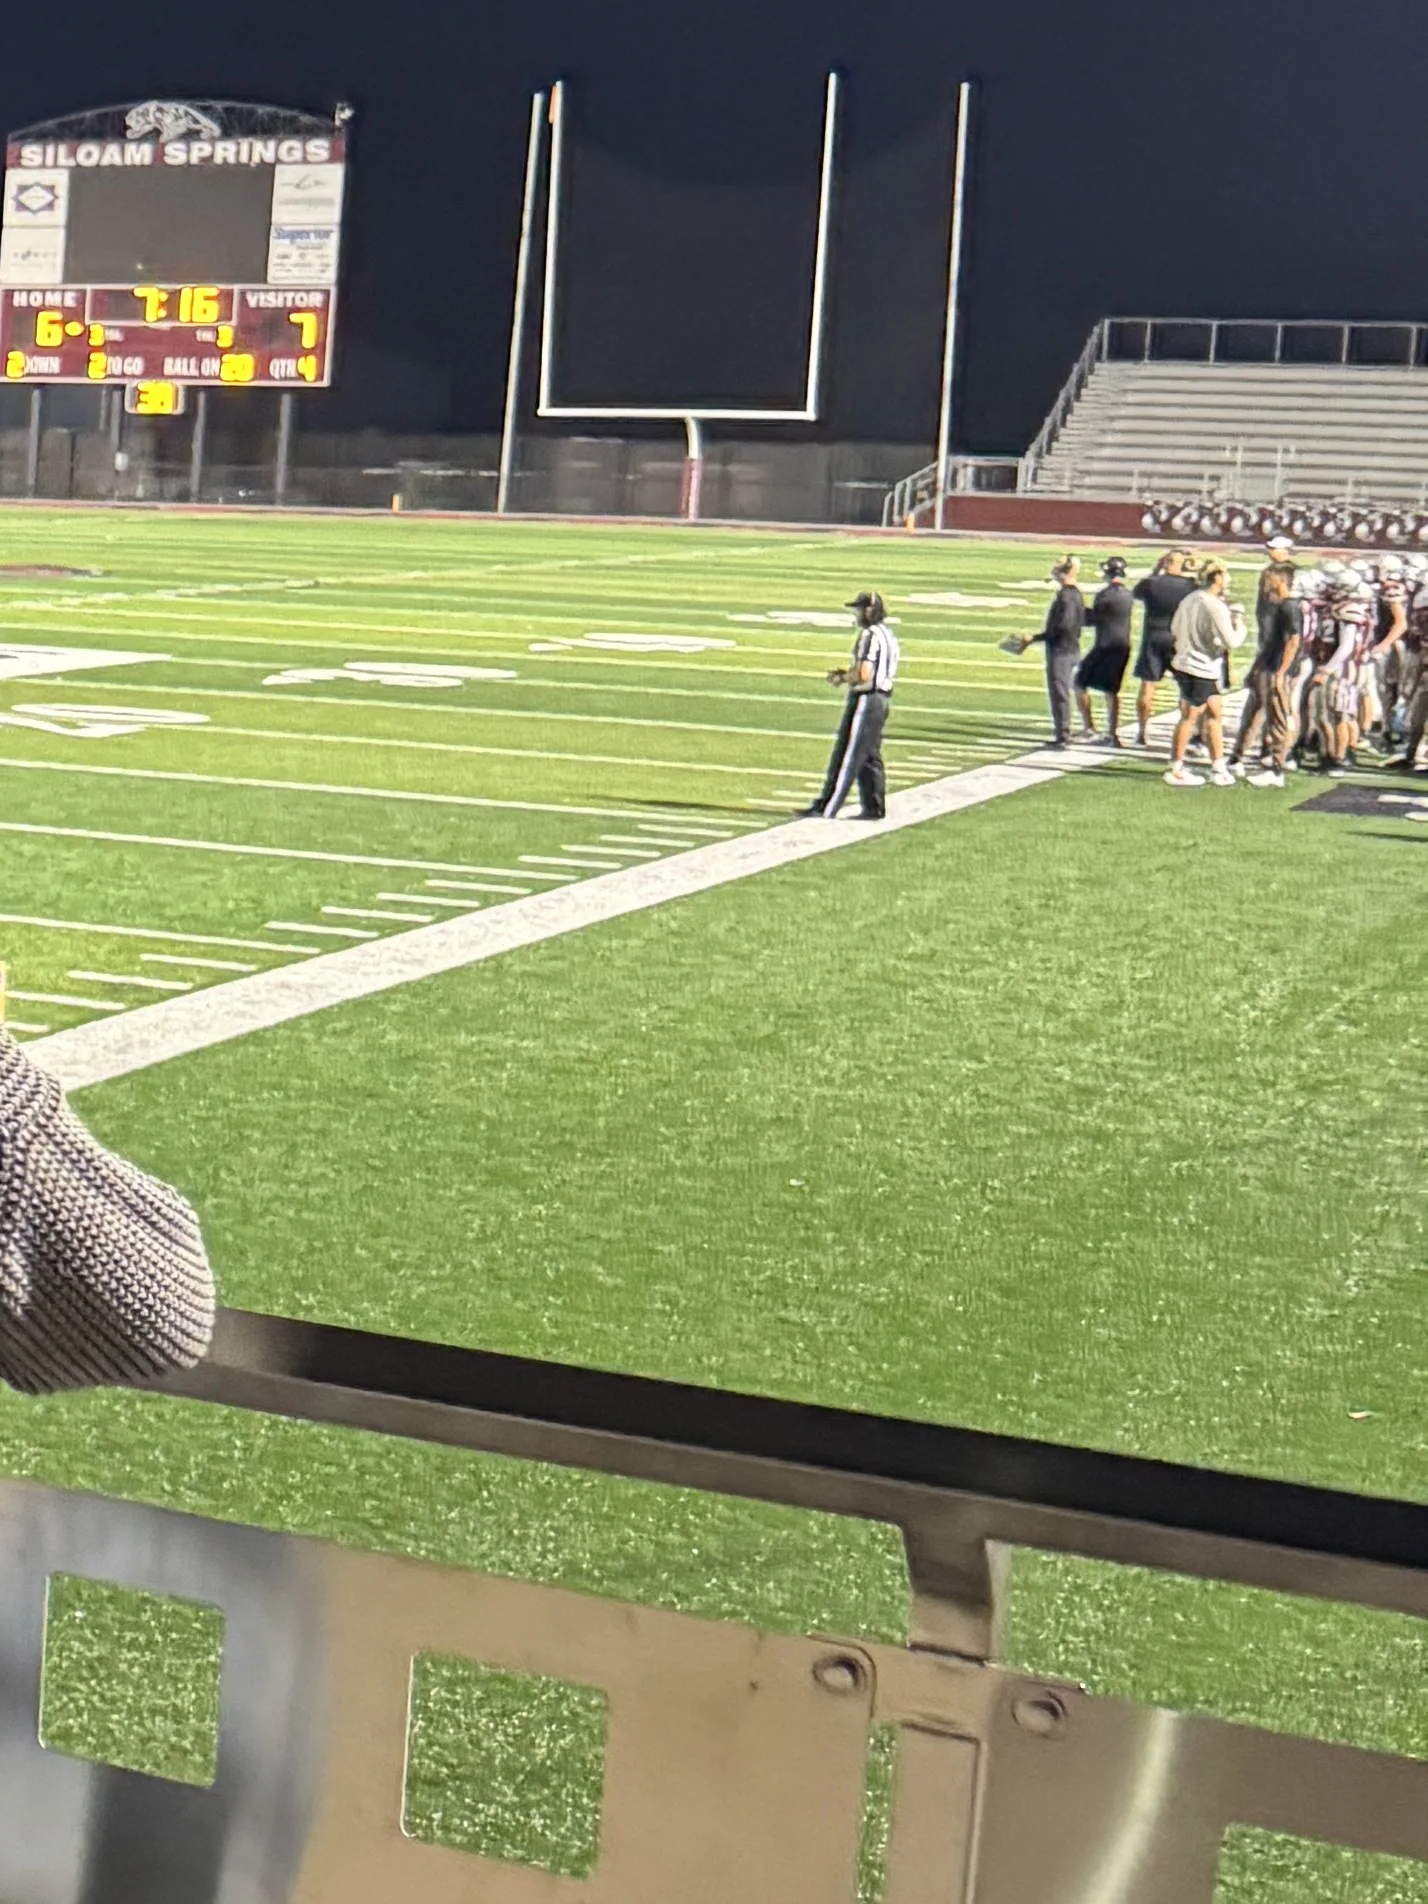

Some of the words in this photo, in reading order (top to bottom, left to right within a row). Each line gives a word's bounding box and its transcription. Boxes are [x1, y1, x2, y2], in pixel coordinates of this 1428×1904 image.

[21, 144, 153, 166] SILOAM
[164, 139, 330, 165] SPRINGS
[12, 290, 77, 307] HOME
[133, 286, 220, 323] 7:16
[245, 291, 324, 308] VISITOR
[35, 310, 63, 347] 6
[288, 312, 318, 349] 7
[163, 357, 200, 376] BALL
